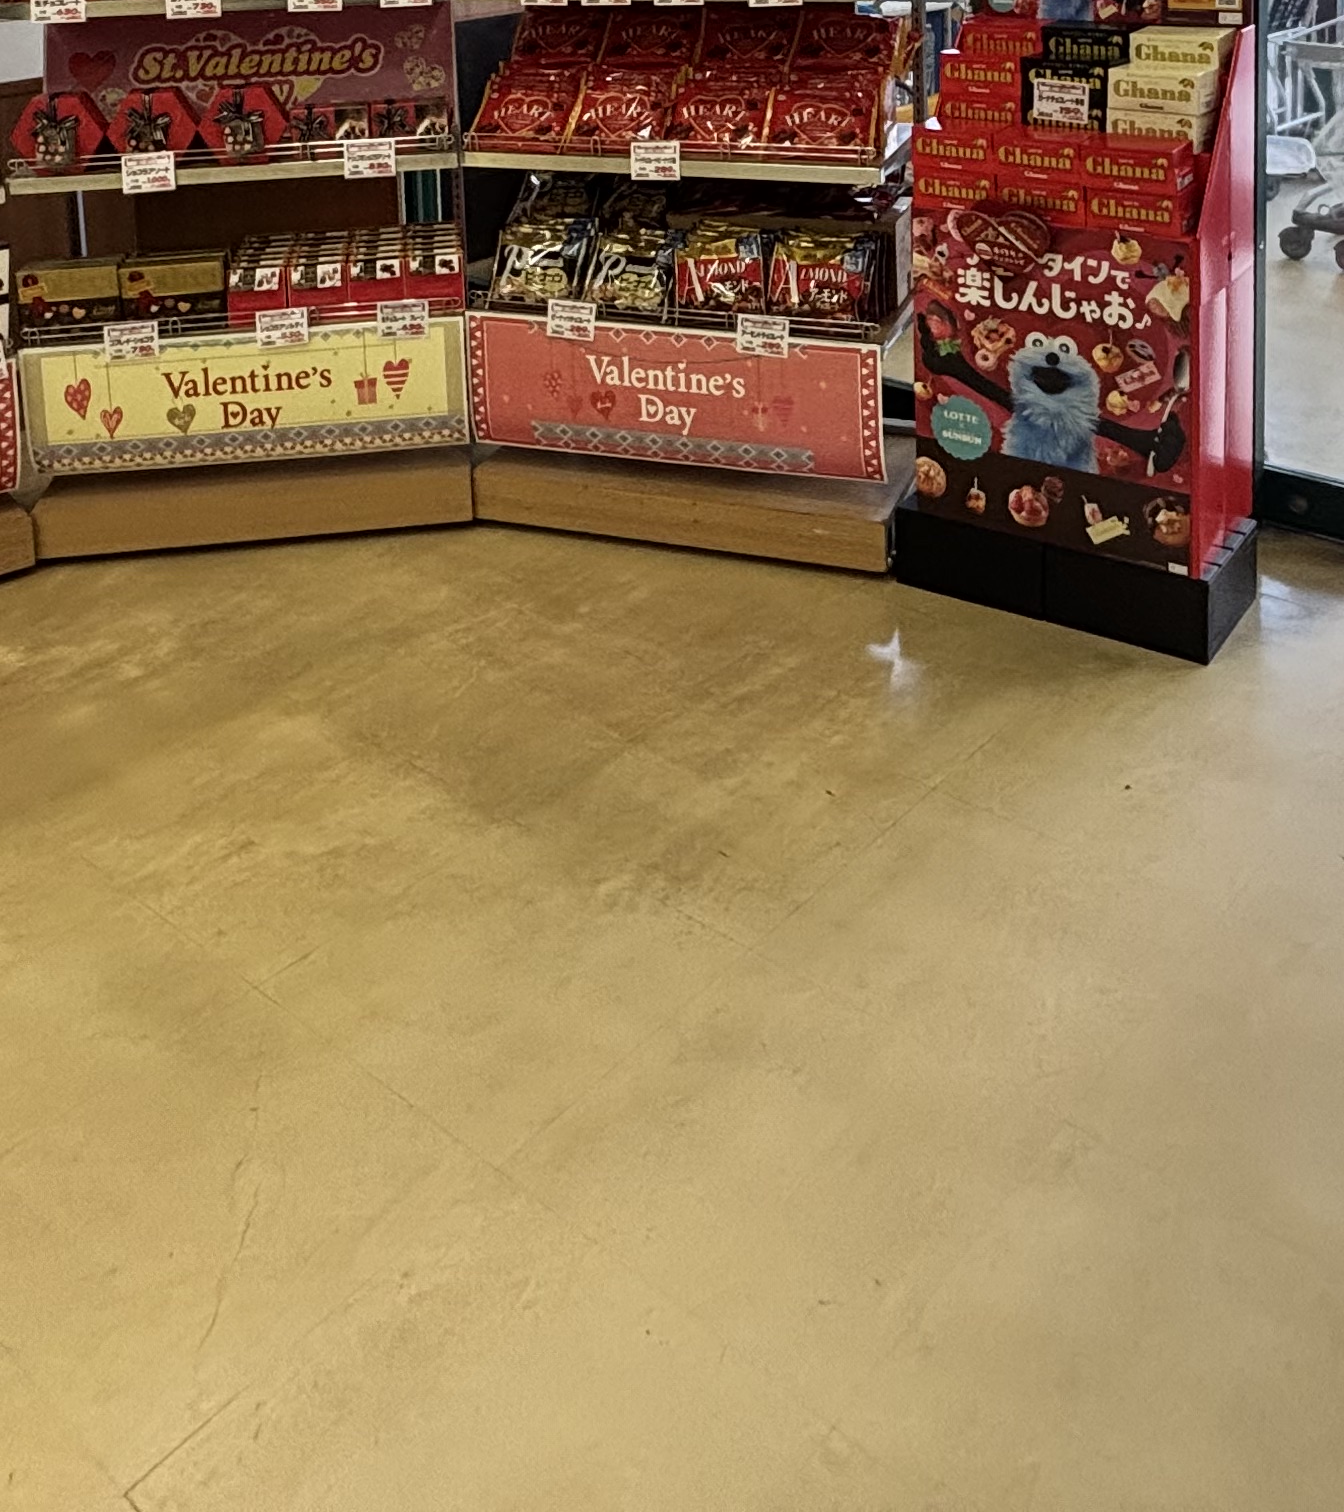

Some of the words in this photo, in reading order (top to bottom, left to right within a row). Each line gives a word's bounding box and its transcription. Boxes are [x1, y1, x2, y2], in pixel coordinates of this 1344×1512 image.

[964, 30, 1037, 55] Ghana
[1047, 35, 1119, 60] Ghana
[1135, 40, 1213, 65] Ghana
[944, 60, 1014, 85] Ghana
[1113, 78, 1192, 104] Ghana
[492, 100, 554, 122] HEART
[681, 100, 748, 122] HEART
[784, 107, 855, 129] HEART
[944, 101, 1014, 124] Ghana
[915, 136, 986, 161] Ghana
[998, 145, 1073, 171] Ghana
[1085, 155, 1167, 182] Ghana
[918, 176, 990, 202] Ghana
[1090, 198, 1172, 224] Ghana
[1037, 252, 1131, 290] タインで
[161, 364, 333, 400] Valentine's
[585, 354, 747, 398] Valentine's
[220, 400, 283, 430] Day
[637, 394, 697, 436] Day
[943, 409, 979, 425] LOTTE
